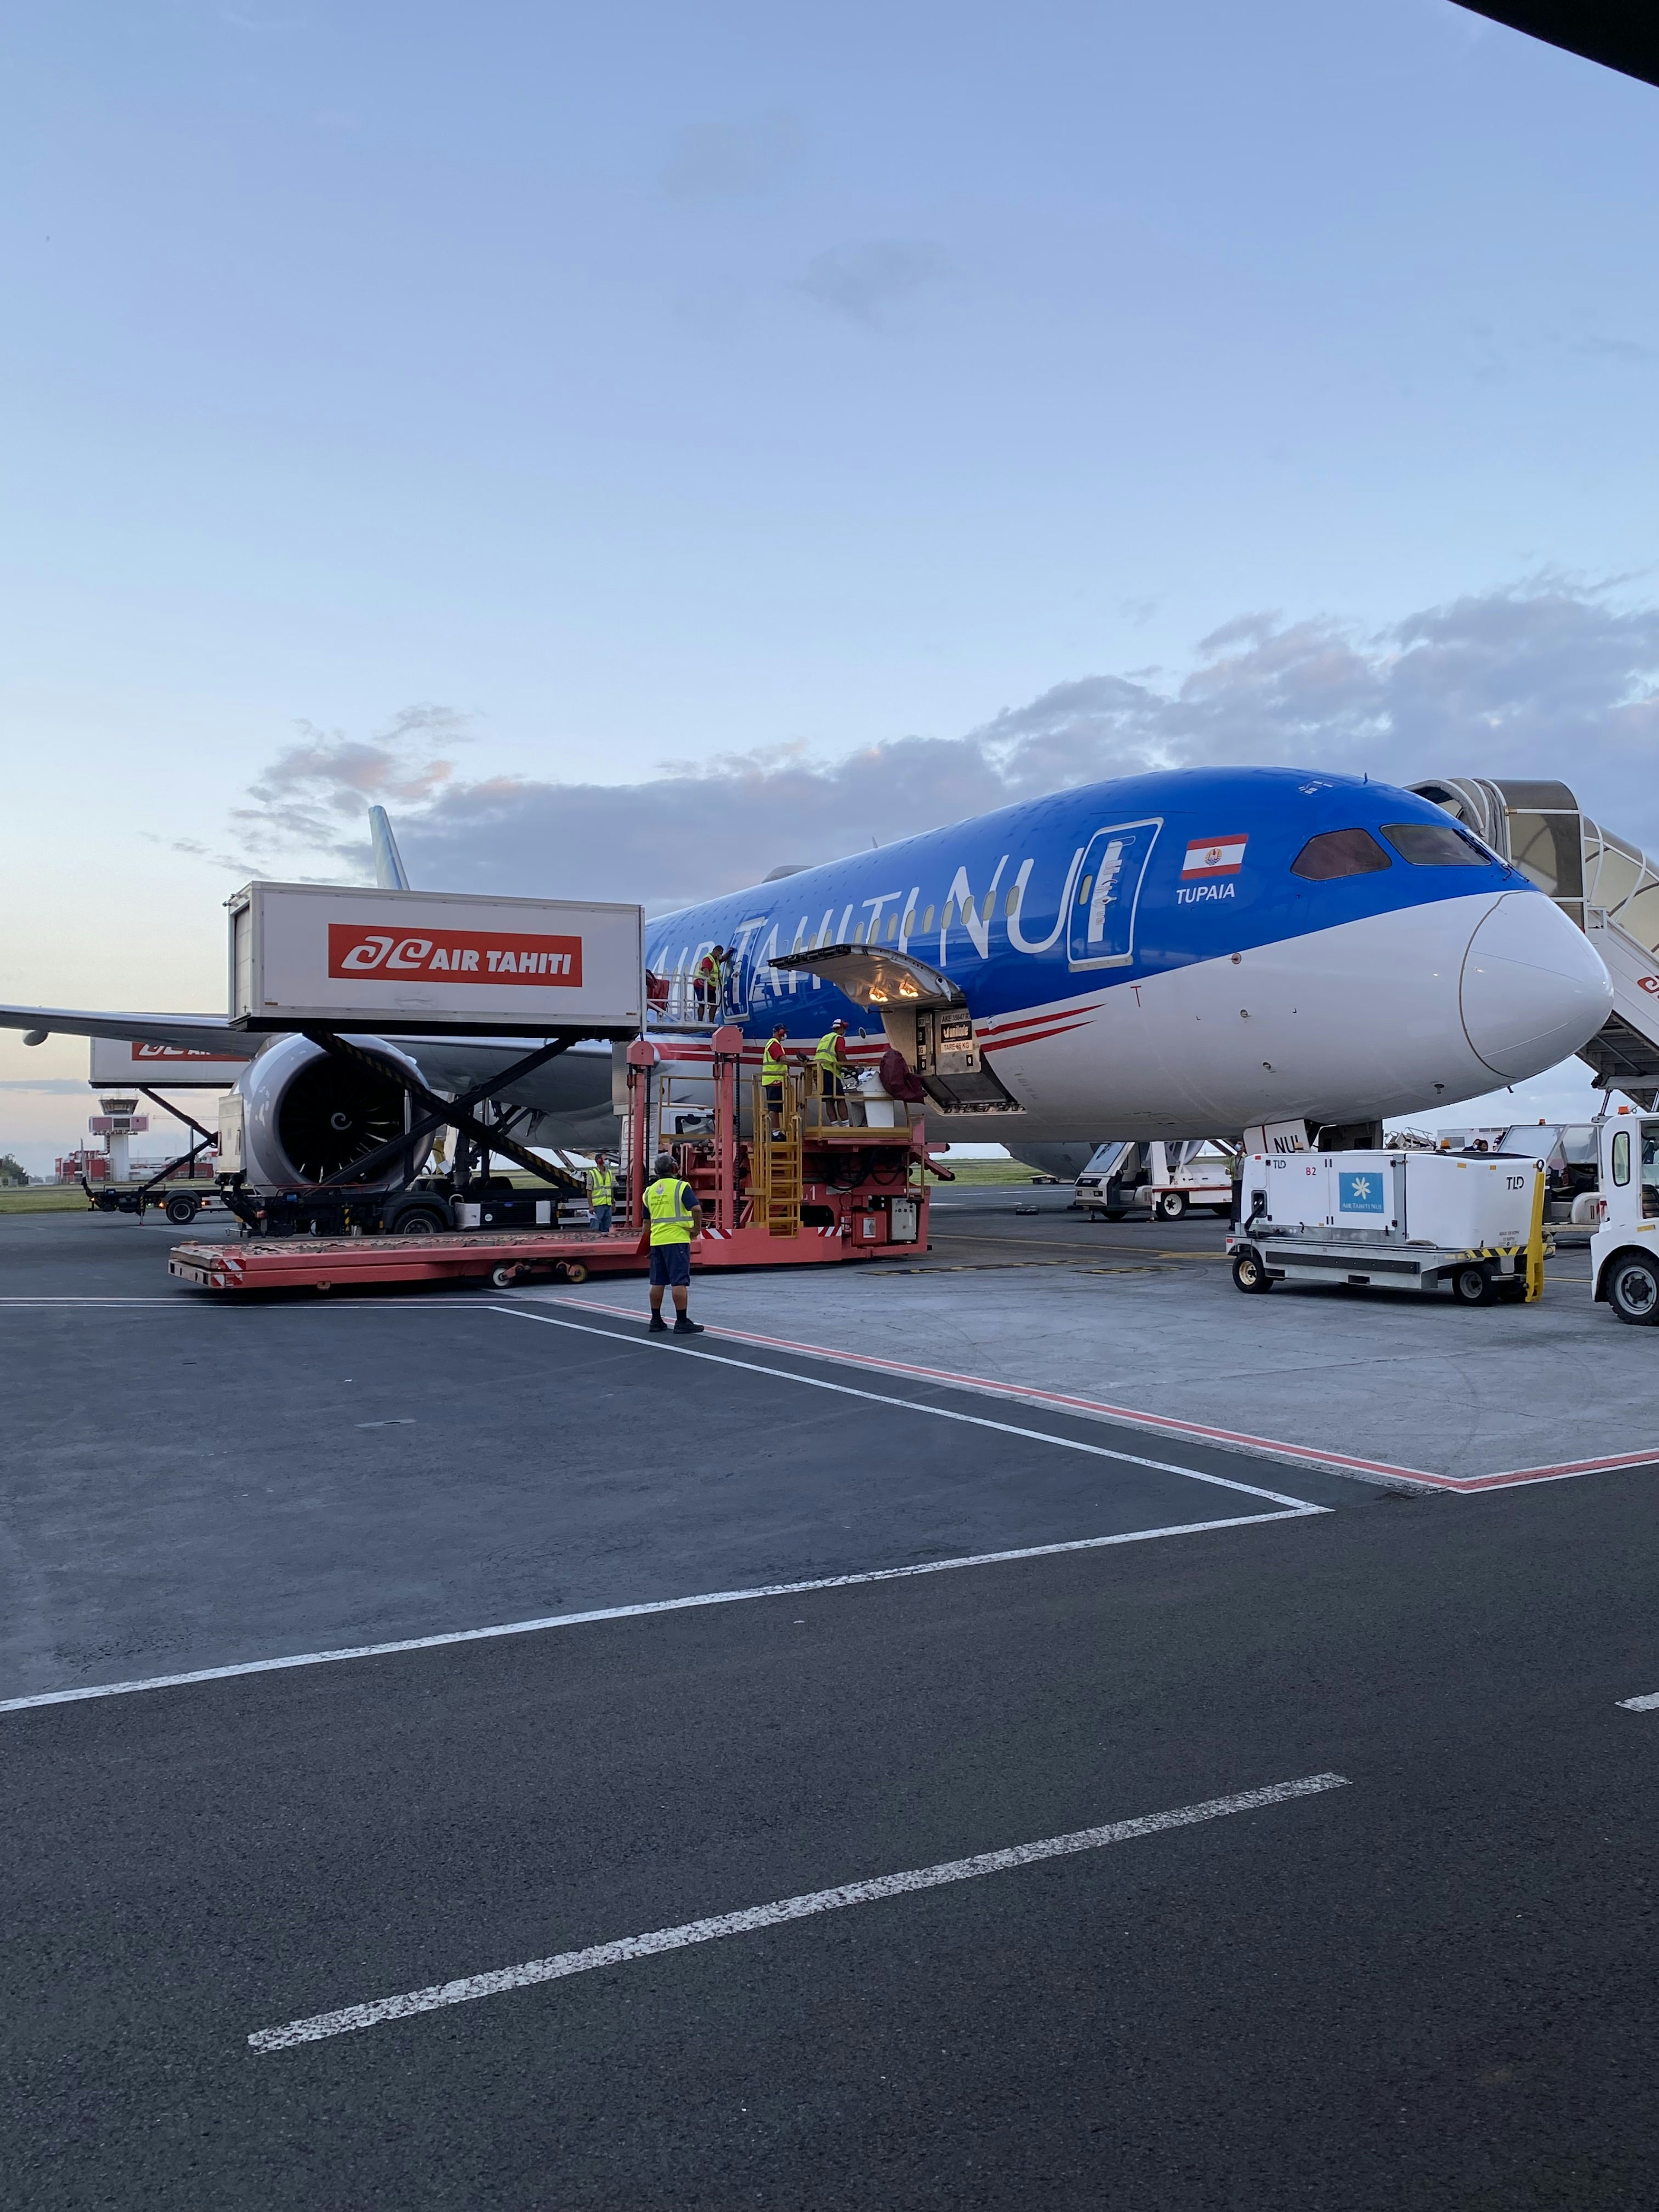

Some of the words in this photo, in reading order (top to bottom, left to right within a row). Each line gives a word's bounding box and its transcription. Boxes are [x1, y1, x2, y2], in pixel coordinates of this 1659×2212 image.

[1176, 883, 1235, 905] TUPAIA
[940, 841, 1123, 968] NUI
[428, 948, 480, 972] AIR
[486, 950, 572, 975] TAHITI
[1273, 1160, 1286, 1169] TLD
[1306, 1167, 1316, 1176] B2
[1506, 1176, 1524, 1190] TLD
